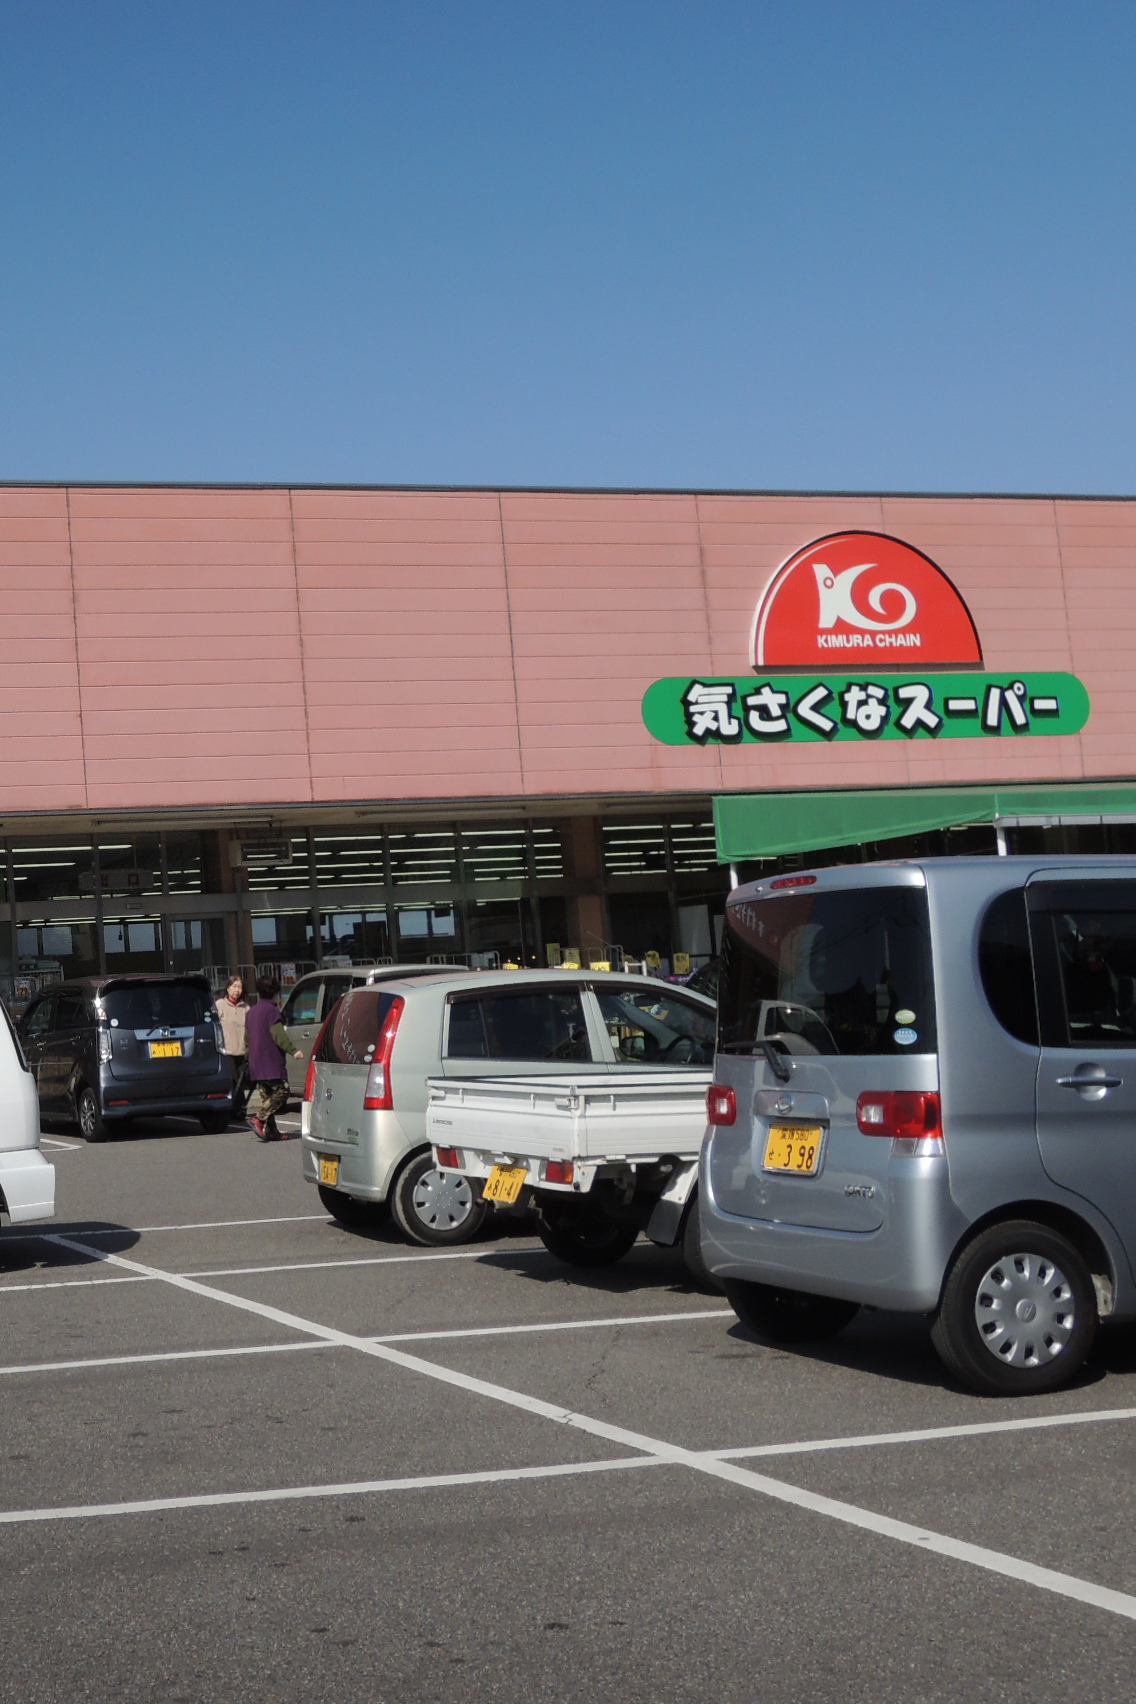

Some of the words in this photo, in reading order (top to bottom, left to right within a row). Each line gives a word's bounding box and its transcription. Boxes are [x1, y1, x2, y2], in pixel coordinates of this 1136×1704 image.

[817, 634, 874, 649] KIMURA
[876, 633, 921, 648] CHAIN
[683, 680, 1060, 745] 気さくなスーパー
